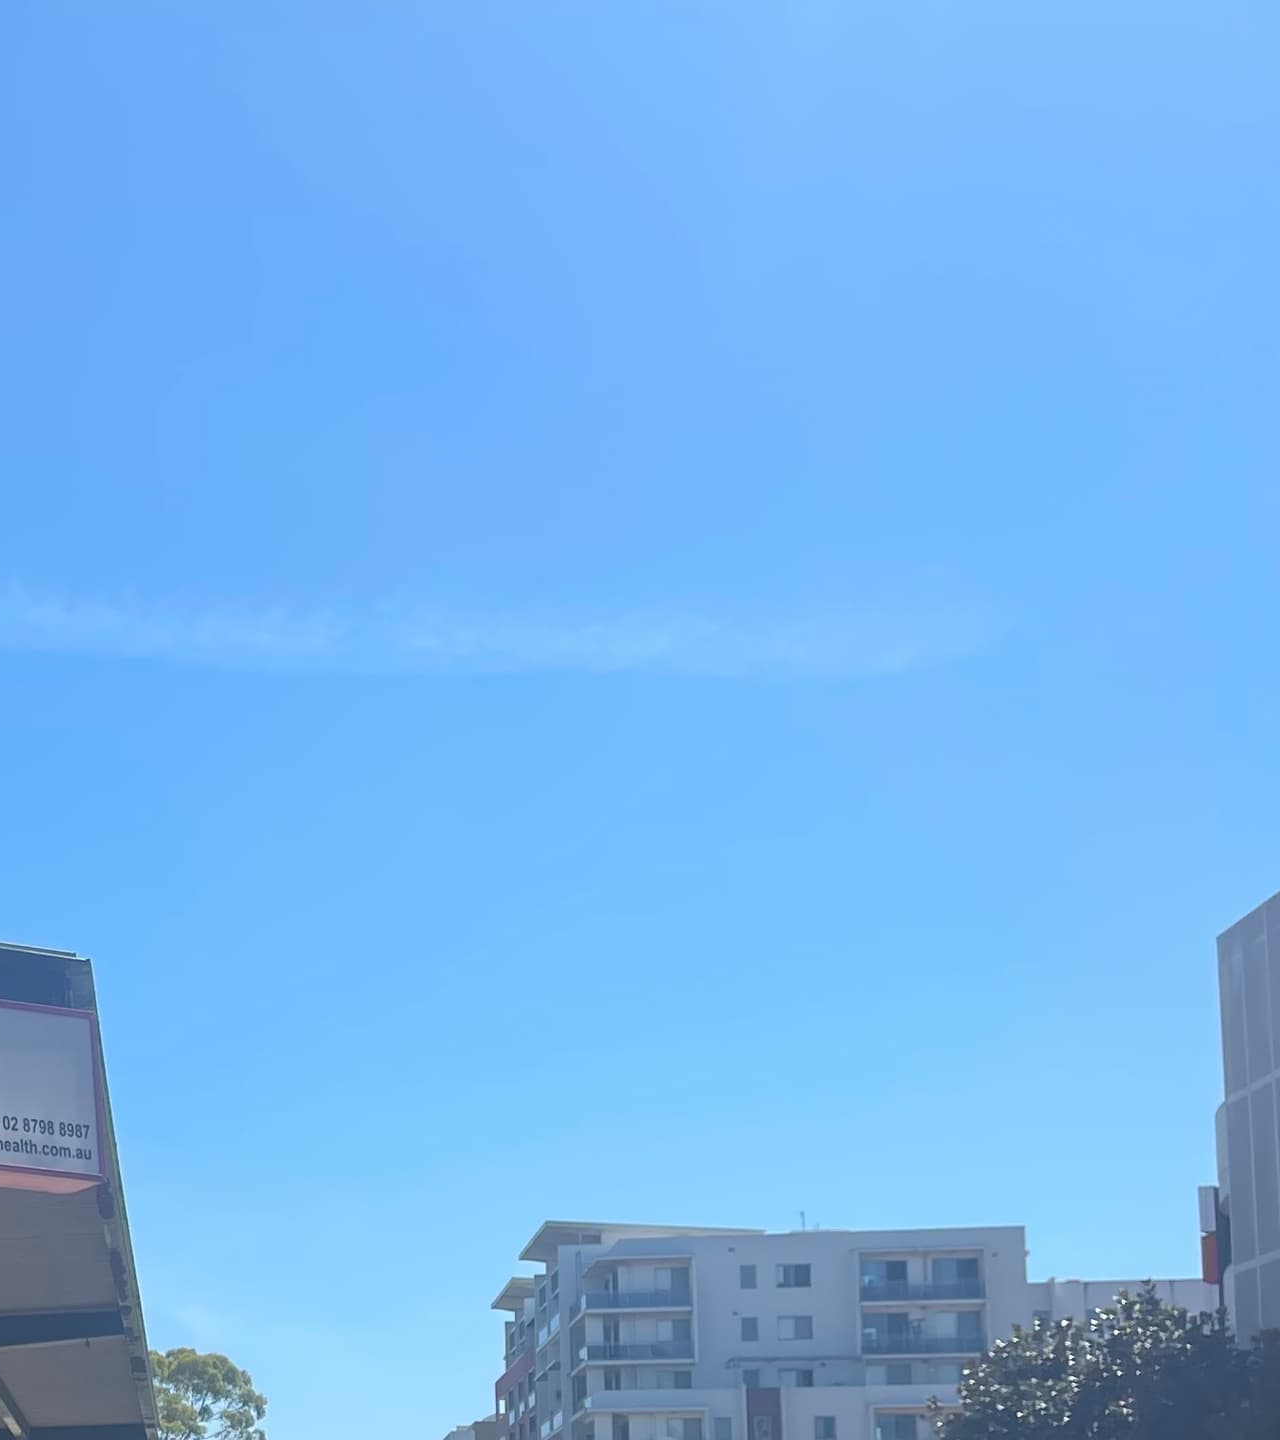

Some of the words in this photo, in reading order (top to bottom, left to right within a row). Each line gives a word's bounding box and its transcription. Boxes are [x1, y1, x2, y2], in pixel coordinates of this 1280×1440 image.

[2, 1115, 19, 1132] 02
[23, 1118, 55, 1136] 8798
[59, 1122, 90, 1139] 8987
